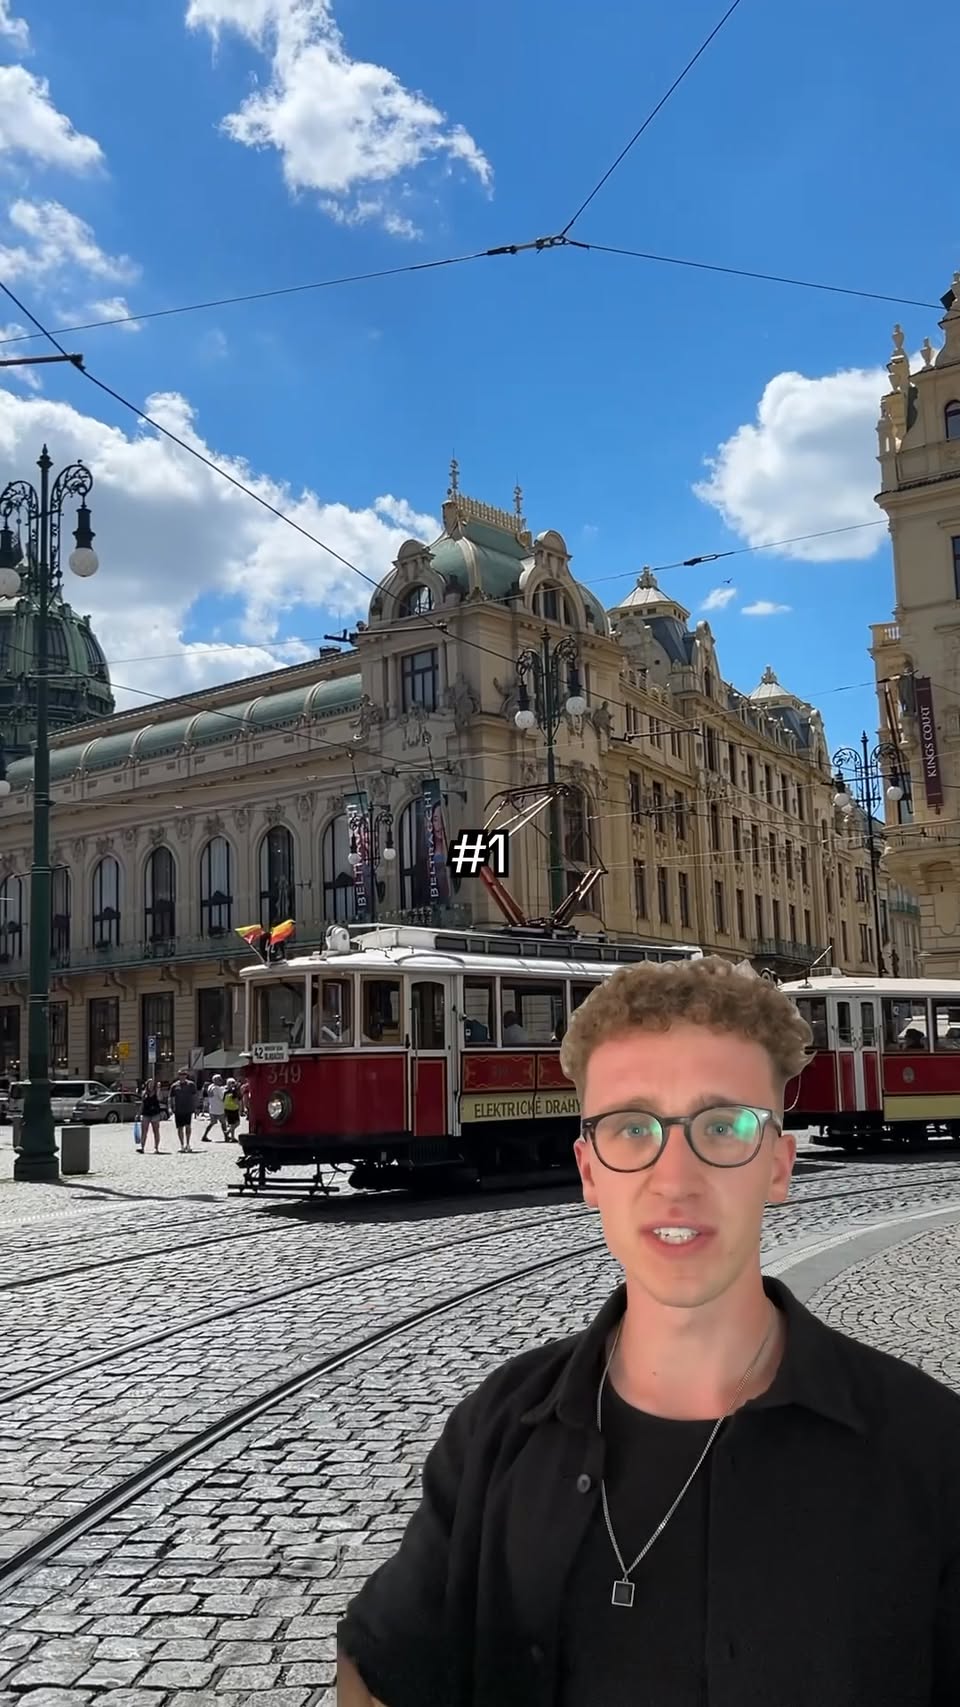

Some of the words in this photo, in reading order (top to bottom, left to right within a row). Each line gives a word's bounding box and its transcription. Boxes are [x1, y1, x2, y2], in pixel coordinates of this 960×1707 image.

[920, 706, 933, 740] COURT
[925, 742, 937, 778] KINGS
[424, 791, 439, 898] BELTRACCHI
[254, 1046, 264, 1059] 42
[268, 1063, 302, 1084] 349
